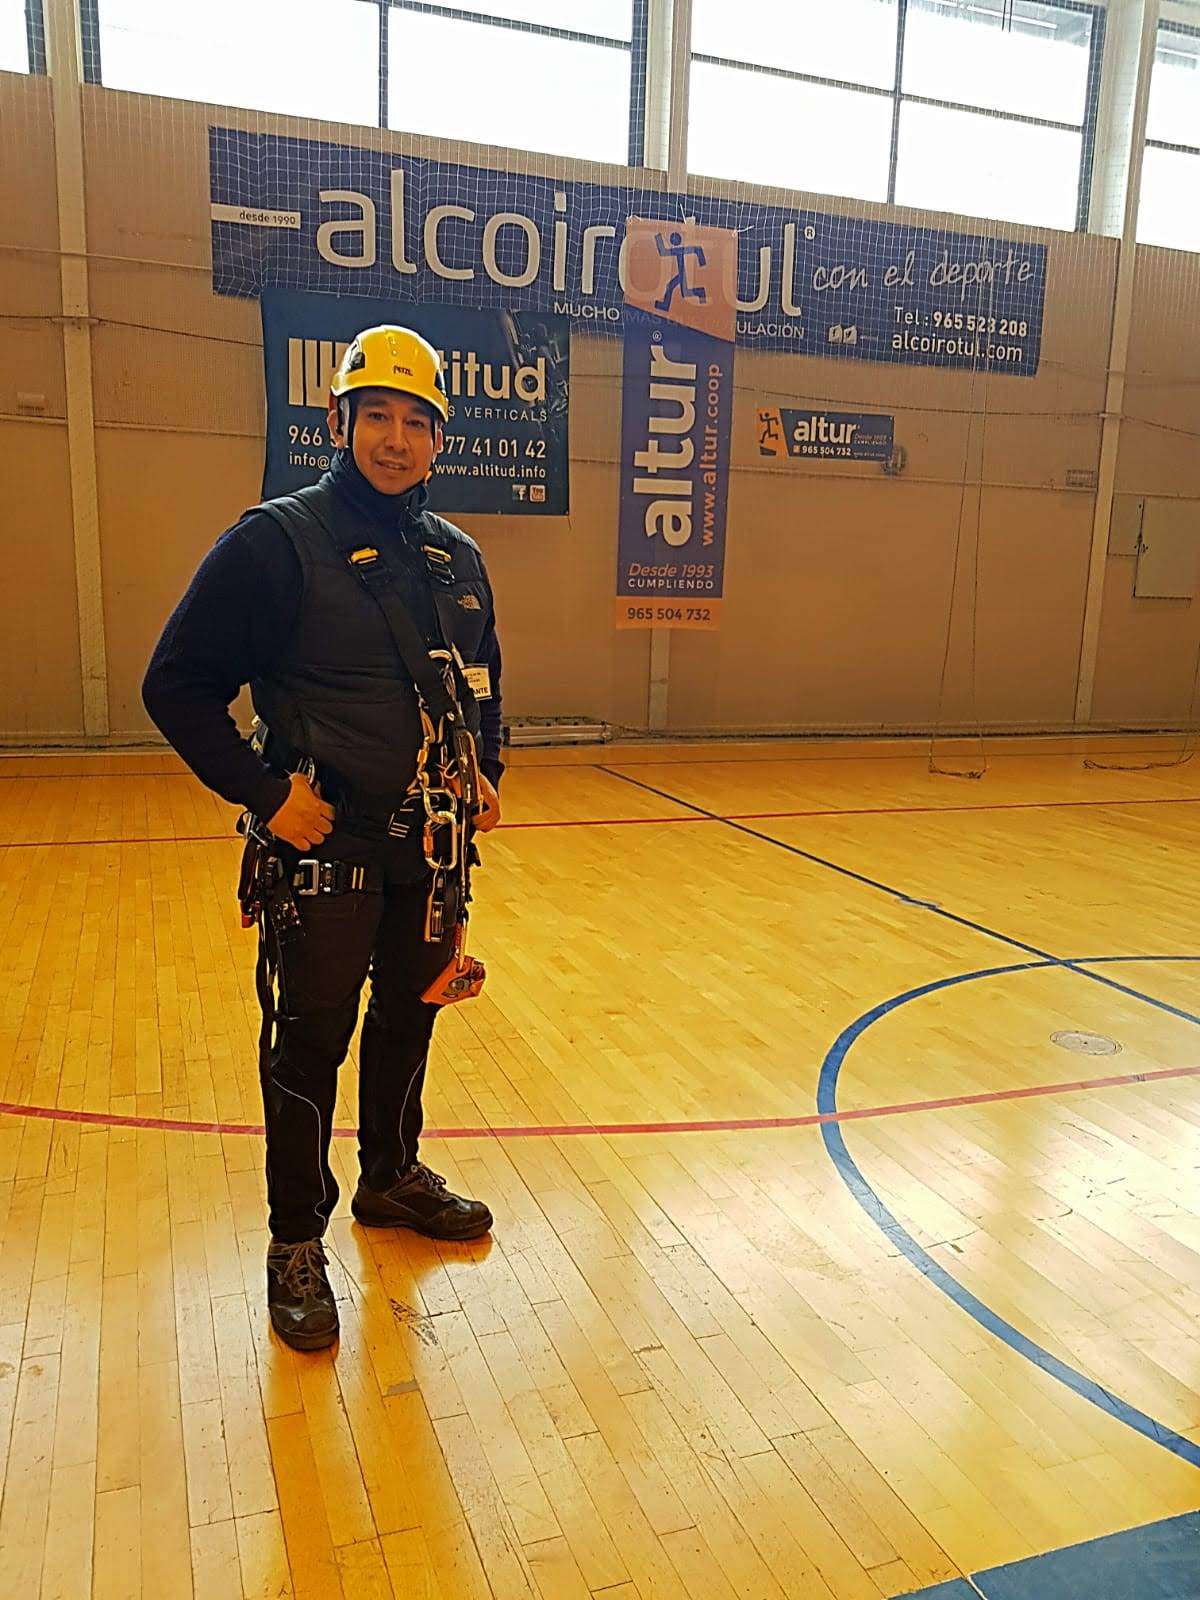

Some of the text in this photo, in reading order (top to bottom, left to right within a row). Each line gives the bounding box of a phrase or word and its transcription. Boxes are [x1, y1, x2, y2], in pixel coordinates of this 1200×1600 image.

[240, 209, 296, 225] desde 1990
[813, 248, 1034, 302] con el deporte
[554, 302, 620, 321] MUCHO
[737, 321, 805, 339] ULACIÓN
[933, 311, 963, 329] 965
[999, 319, 1028, 337] 208
[892, 330, 1023, 362] alcoirotul.com
[437, 350, 546, 402] itud
[464, 406, 547, 422] VERTICALS
[288, 425, 323, 446] 966
[793, 416, 857, 444] altur
[437, 435, 546, 459] 77 41 01 42
[633, 344, 697, 547] altur
[699, 363, 724, 546] www.altur.coop
[801, 445, 818, 455] 965
[820, 446, 835, 455] 504
[836, 447, 852, 456] 732
[434, 463, 546, 479] www.altitud.info
[628, 563, 715, 578] Desde 1993
[628, 578, 714, 590] CUMPLIENDO
[627, 607, 711, 621] 965 504 732
